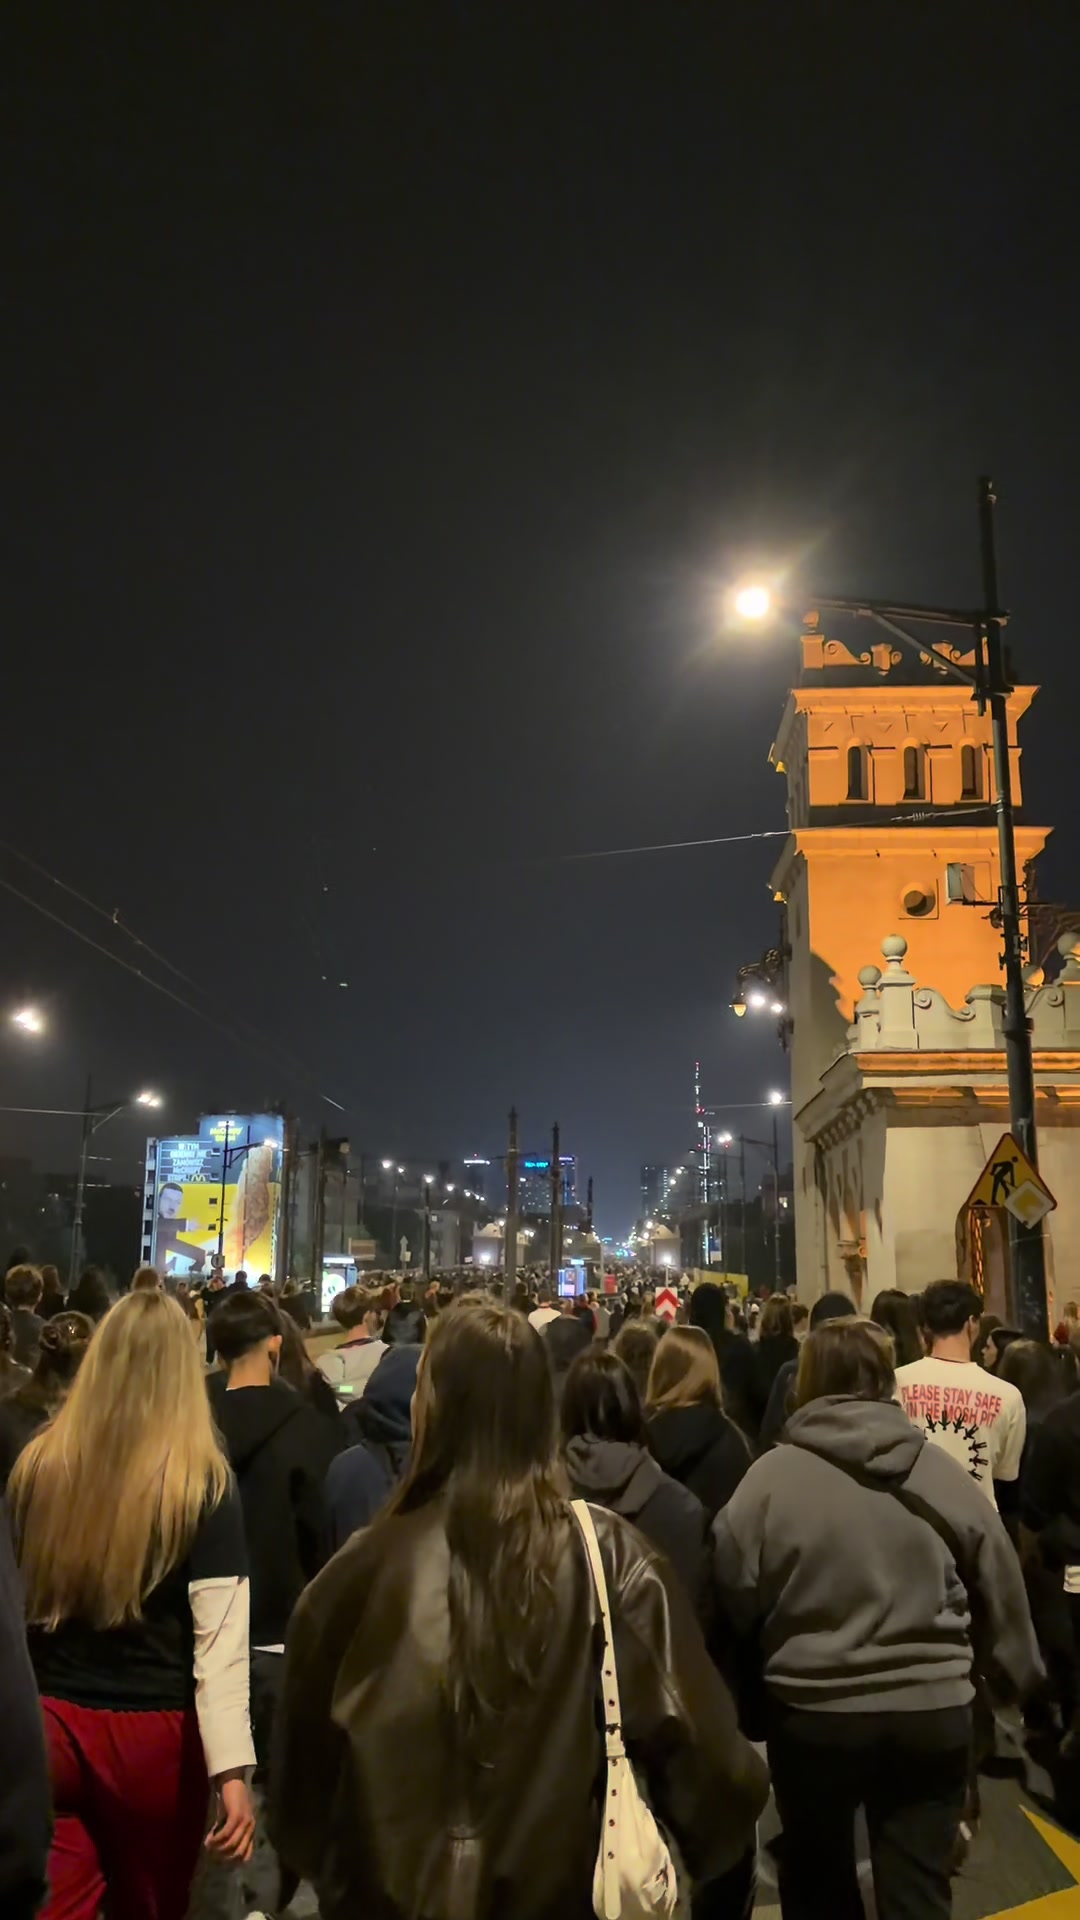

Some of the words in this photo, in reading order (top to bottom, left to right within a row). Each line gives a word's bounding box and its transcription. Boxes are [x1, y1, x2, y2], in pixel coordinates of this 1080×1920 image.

[901, 1384, 940, 1402] PLEASE
[943, 1387, 972, 1405] STAY
[974, 1391, 1002, 1413] SAFE
[906, 1402, 918, 1418] IN
[920, 1401, 940, 1419] THE
[943, 1405, 978, 1424] MOSH
[980, 1410, 997, 1428] PIT
